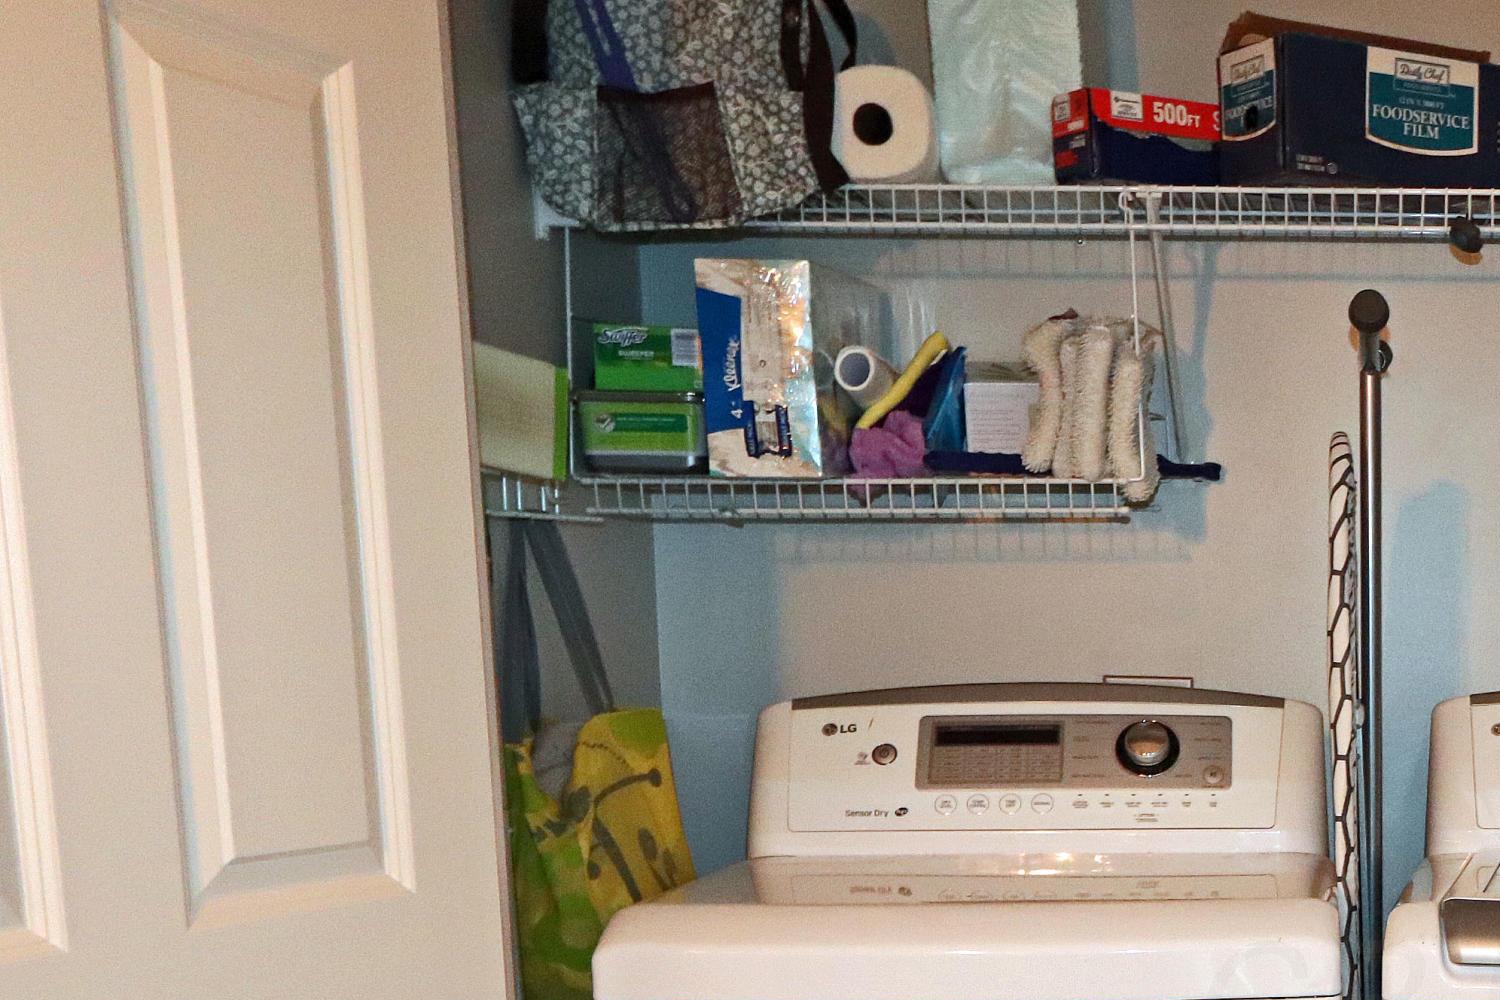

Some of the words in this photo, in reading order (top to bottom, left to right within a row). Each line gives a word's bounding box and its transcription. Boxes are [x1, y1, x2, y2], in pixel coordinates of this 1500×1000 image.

[1400, 63, 1422, 80] Daily
[1423, 67, 1447, 83] Chef
[1372, 104, 1471, 130] FOODSERVICE
[1403, 122, 1440, 140] FILM
[598, 328, 648, 347] Swiffer
[723, 335, 741, 392] Kleenex
[840, 724, 857, 733] LG
[845, 809, 872, 817] Sensor
[874, 809, 889, 817] Dry
